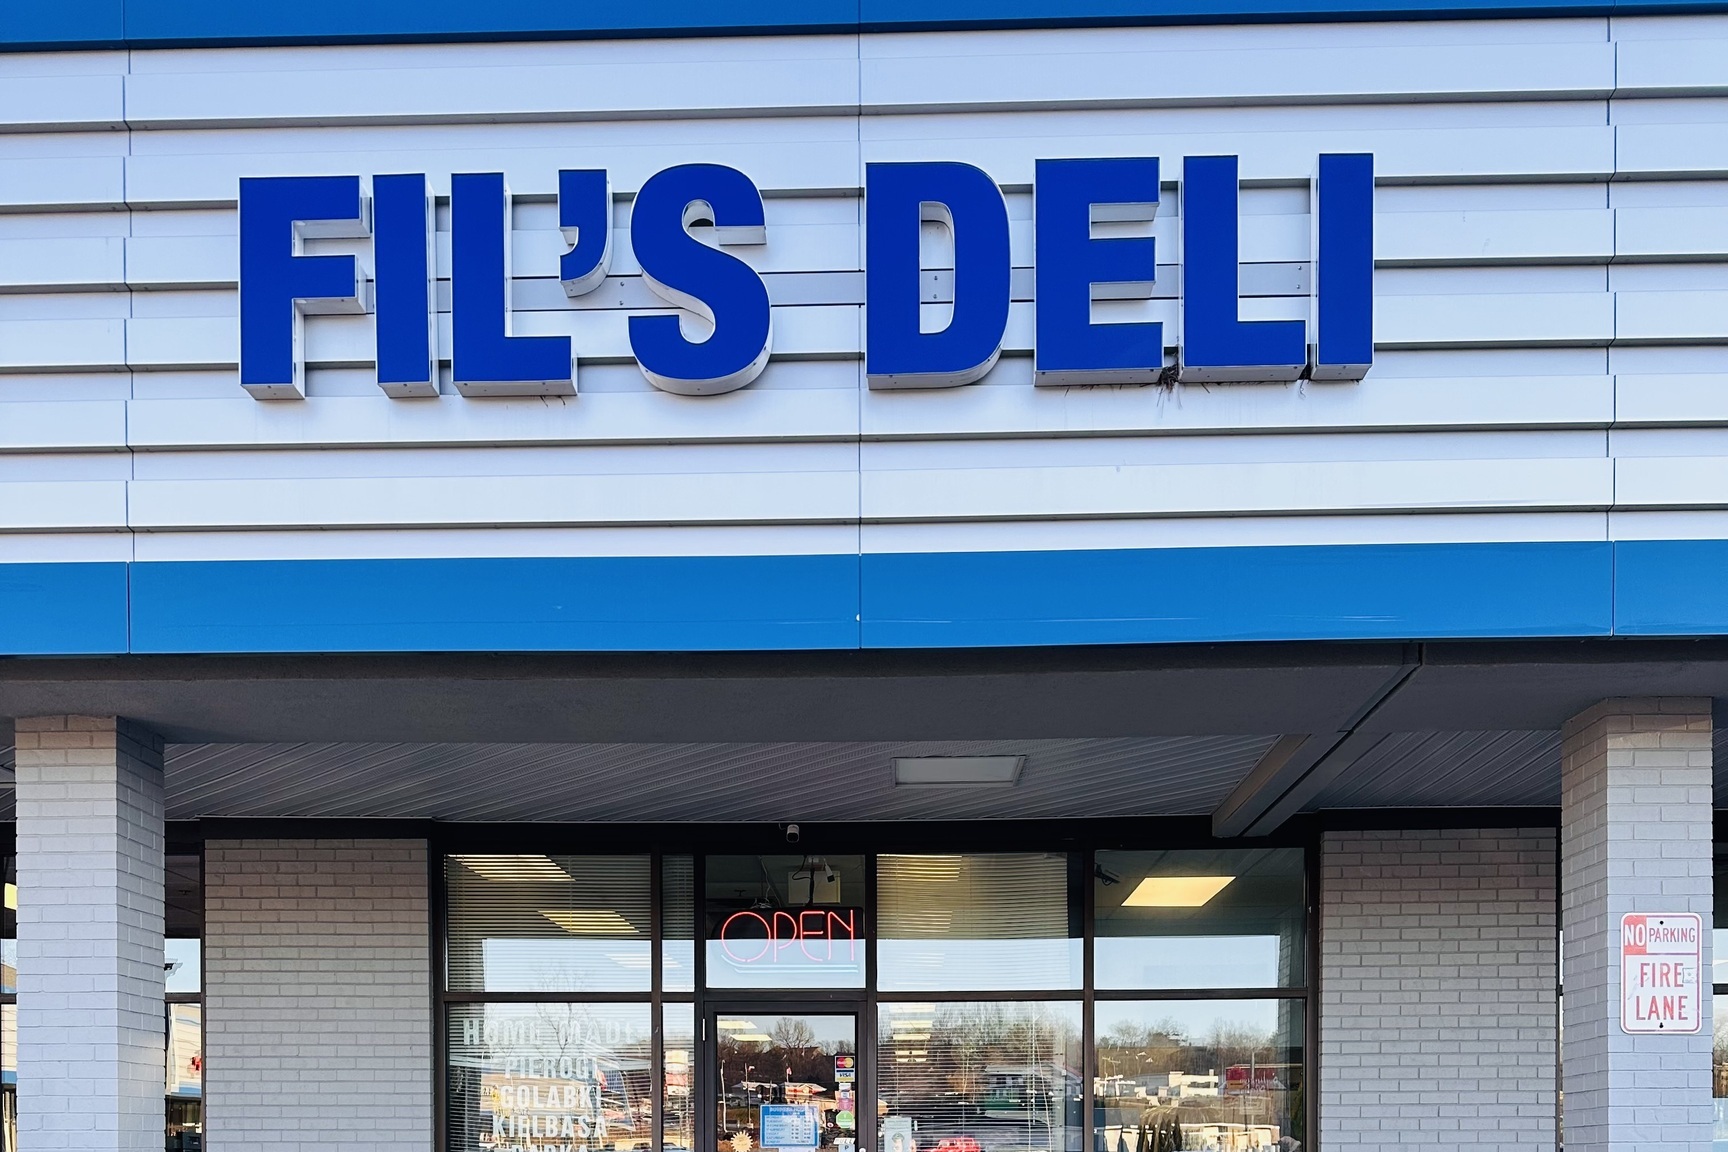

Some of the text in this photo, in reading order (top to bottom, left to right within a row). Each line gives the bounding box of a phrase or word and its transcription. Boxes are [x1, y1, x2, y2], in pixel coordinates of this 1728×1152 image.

[239, 152, 1375, 390] FIL'S DELI
[720, 909, 855, 963] OPEN
[1624, 924, 1696, 946] NO PARKING
[1640, 962, 1684, 988] FIRE
[1635, 995, 1689, 1021] LANE
[463, 1019, 542, 1045] HOME
[504, 1056, 598, 1079] PIEROGI
[500, 1084, 602, 1109] GOLABKI
[492, 1115, 608, 1138] KIELBASA
